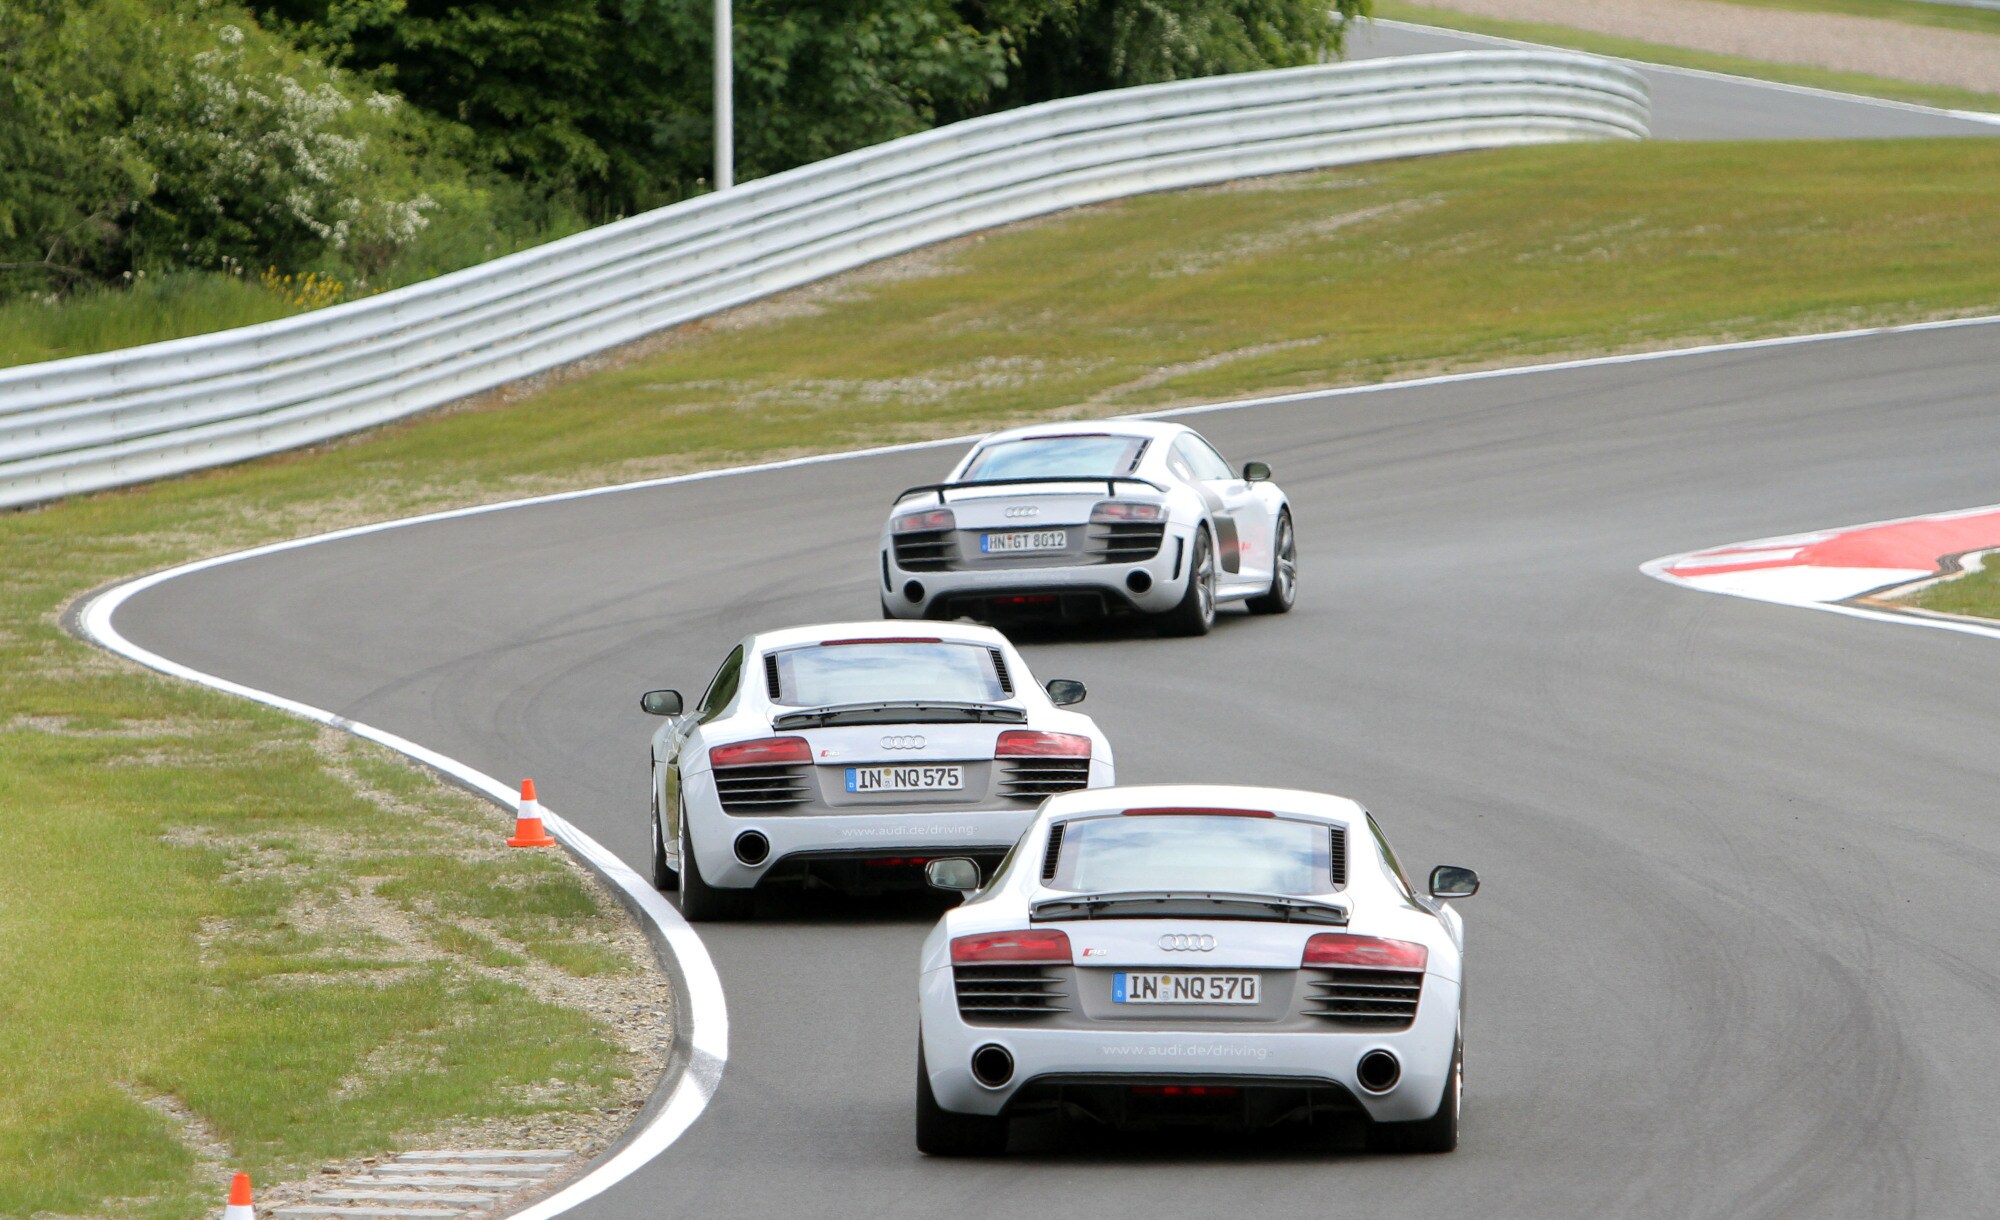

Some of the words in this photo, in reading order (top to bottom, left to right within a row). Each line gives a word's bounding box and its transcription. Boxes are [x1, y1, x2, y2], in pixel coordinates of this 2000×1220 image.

[859, 769, 881, 789] IN
[894, 768, 920, 787] NQ
[923, 767, 959, 787] 575
[841, 824, 975, 837] www.audi.de/driving
[1129, 976, 1157, 999] IN
[1174, 976, 1205, 999] NQ
[1210, 976, 1256, 1000] 570
[1102, 1043, 1267, 1061] www.audi.de/driving
